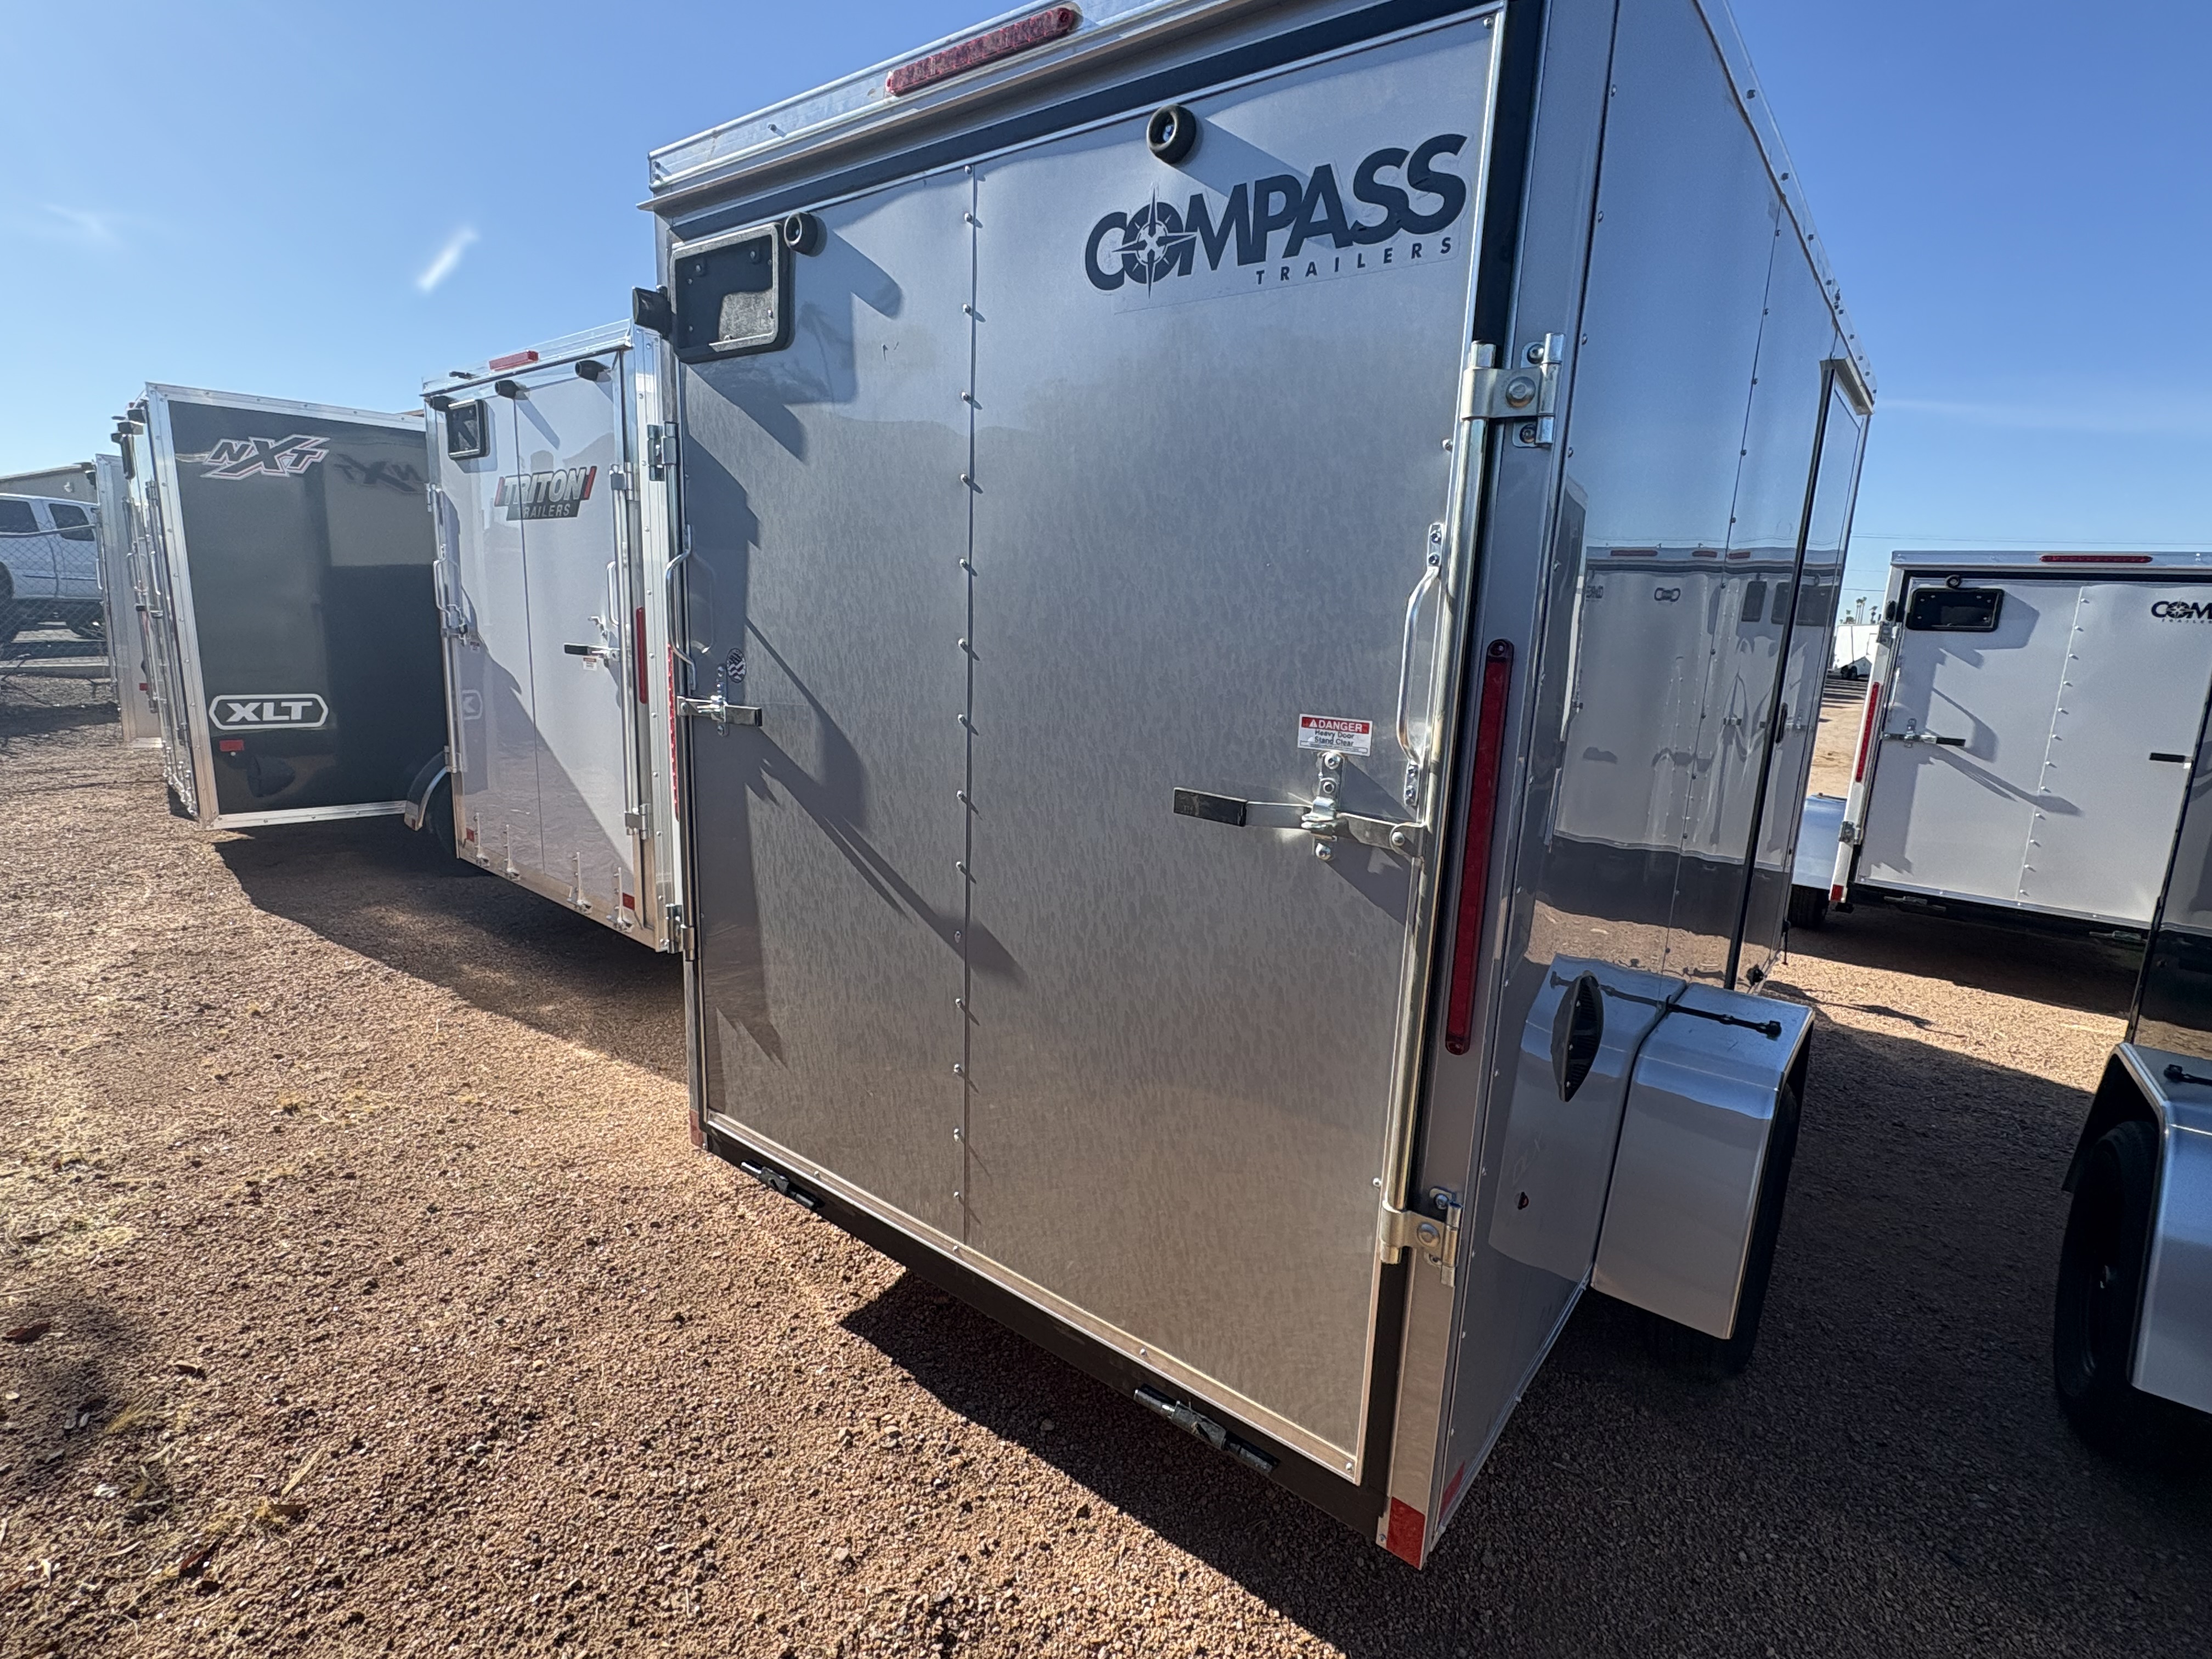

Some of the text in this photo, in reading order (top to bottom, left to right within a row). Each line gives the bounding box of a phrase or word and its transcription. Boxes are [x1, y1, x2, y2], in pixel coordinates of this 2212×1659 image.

[1084, 133, 1468, 292] COMPASS
[1256, 237, 1452, 285] TRAILERS
[201, 435, 330, 481] NXT
[504, 467, 587, 505] TRITON
[225, 701, 313, 723] XLT
[1318, 719, 1363, 732] DANGER
[1314, 730, 1335, 740] Heavy
[1314, 736, 1354, 747] Stand Clear
